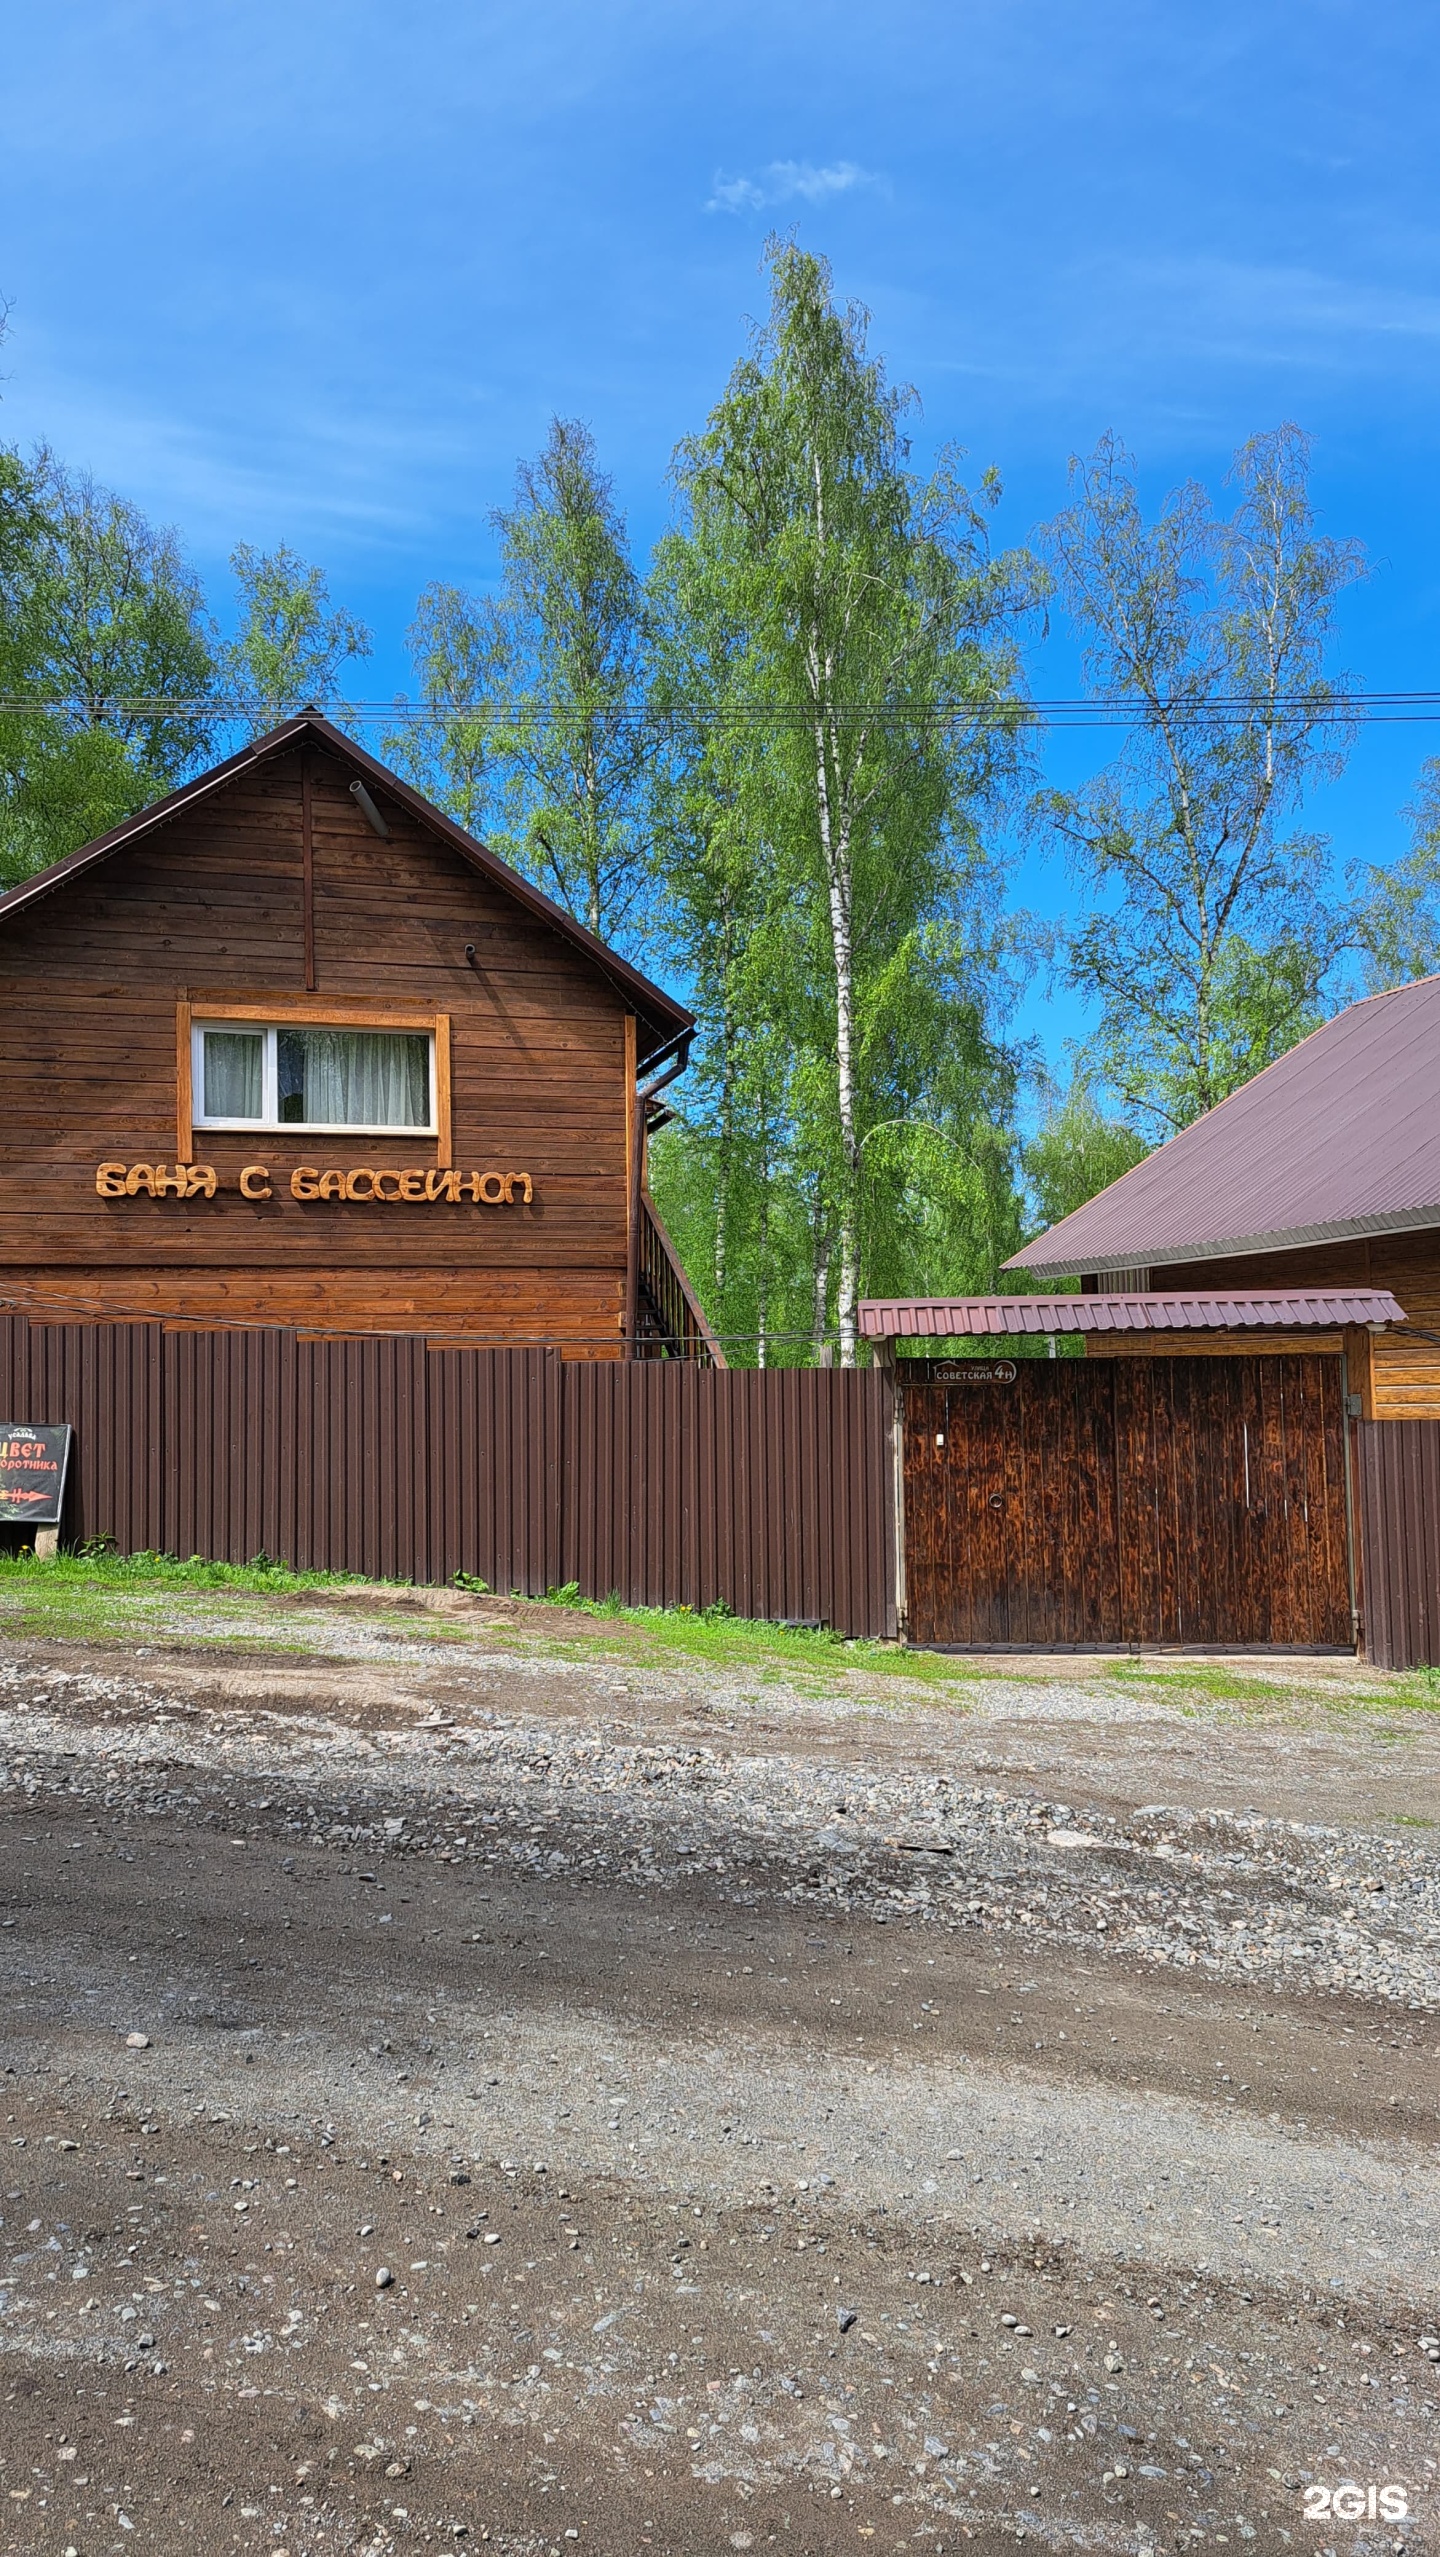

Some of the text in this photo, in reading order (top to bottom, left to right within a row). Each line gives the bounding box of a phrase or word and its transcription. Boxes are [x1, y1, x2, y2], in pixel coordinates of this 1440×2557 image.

[96, 1162, 217, 1198] БАНЯ
[239, 1165, 273, 1199] С
[936, 1371, 993, 1380] СОВЕТСКАЯ
